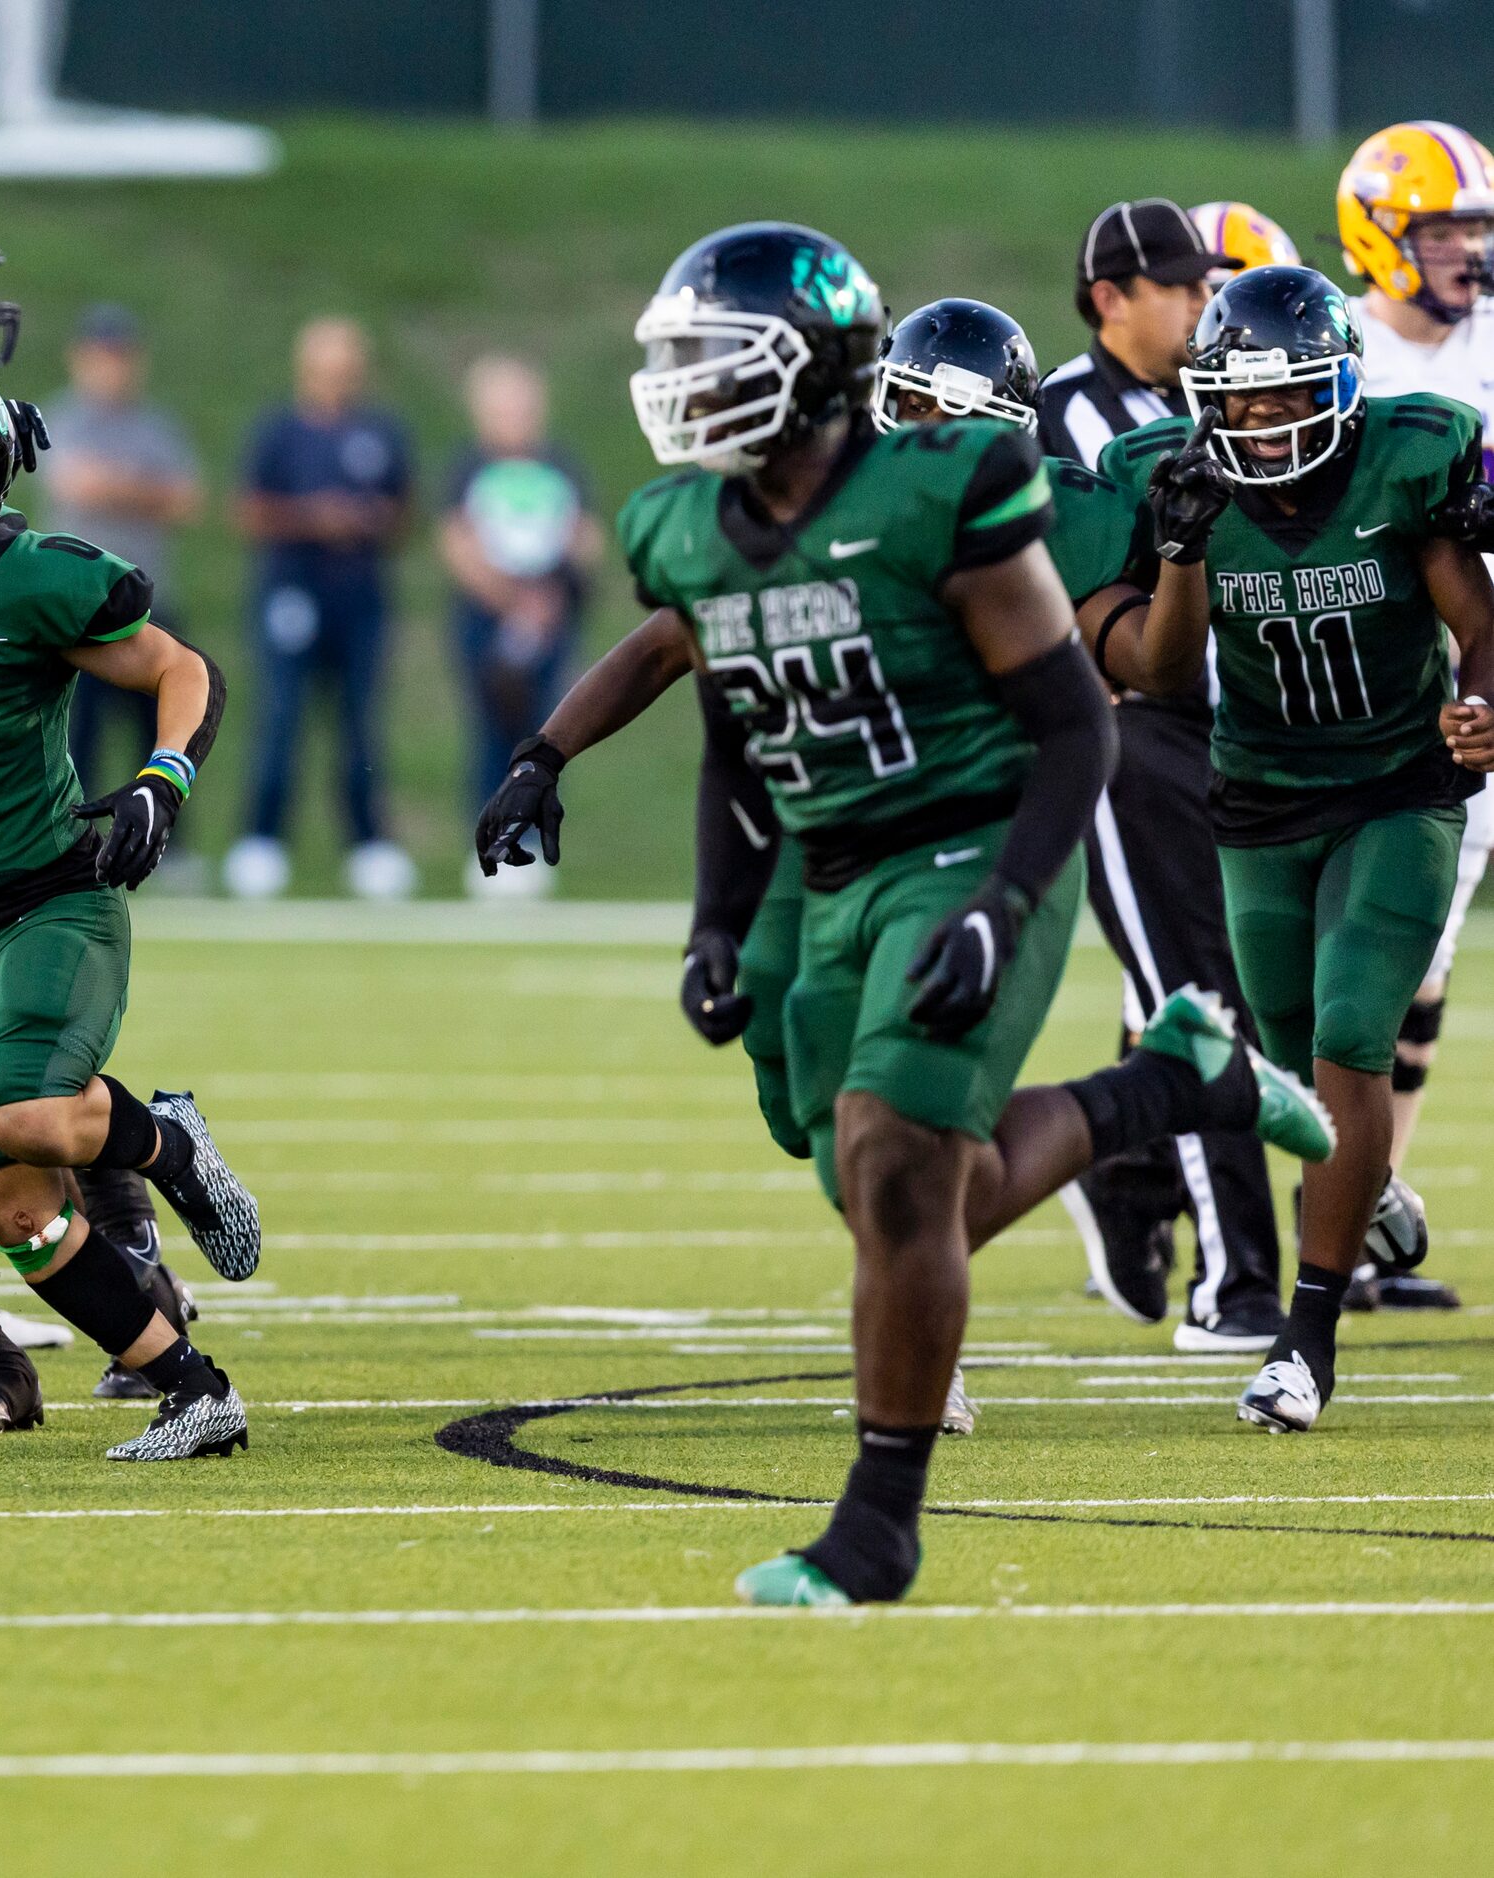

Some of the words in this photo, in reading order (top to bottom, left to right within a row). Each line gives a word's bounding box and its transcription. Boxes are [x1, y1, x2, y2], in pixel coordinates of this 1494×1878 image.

[1217, 572, 1286, 613] THE
[1293, 559, 1386, 611] HERD
[707, 635, 917, 792] 24
[1257, 611, 1373, 725] 11
